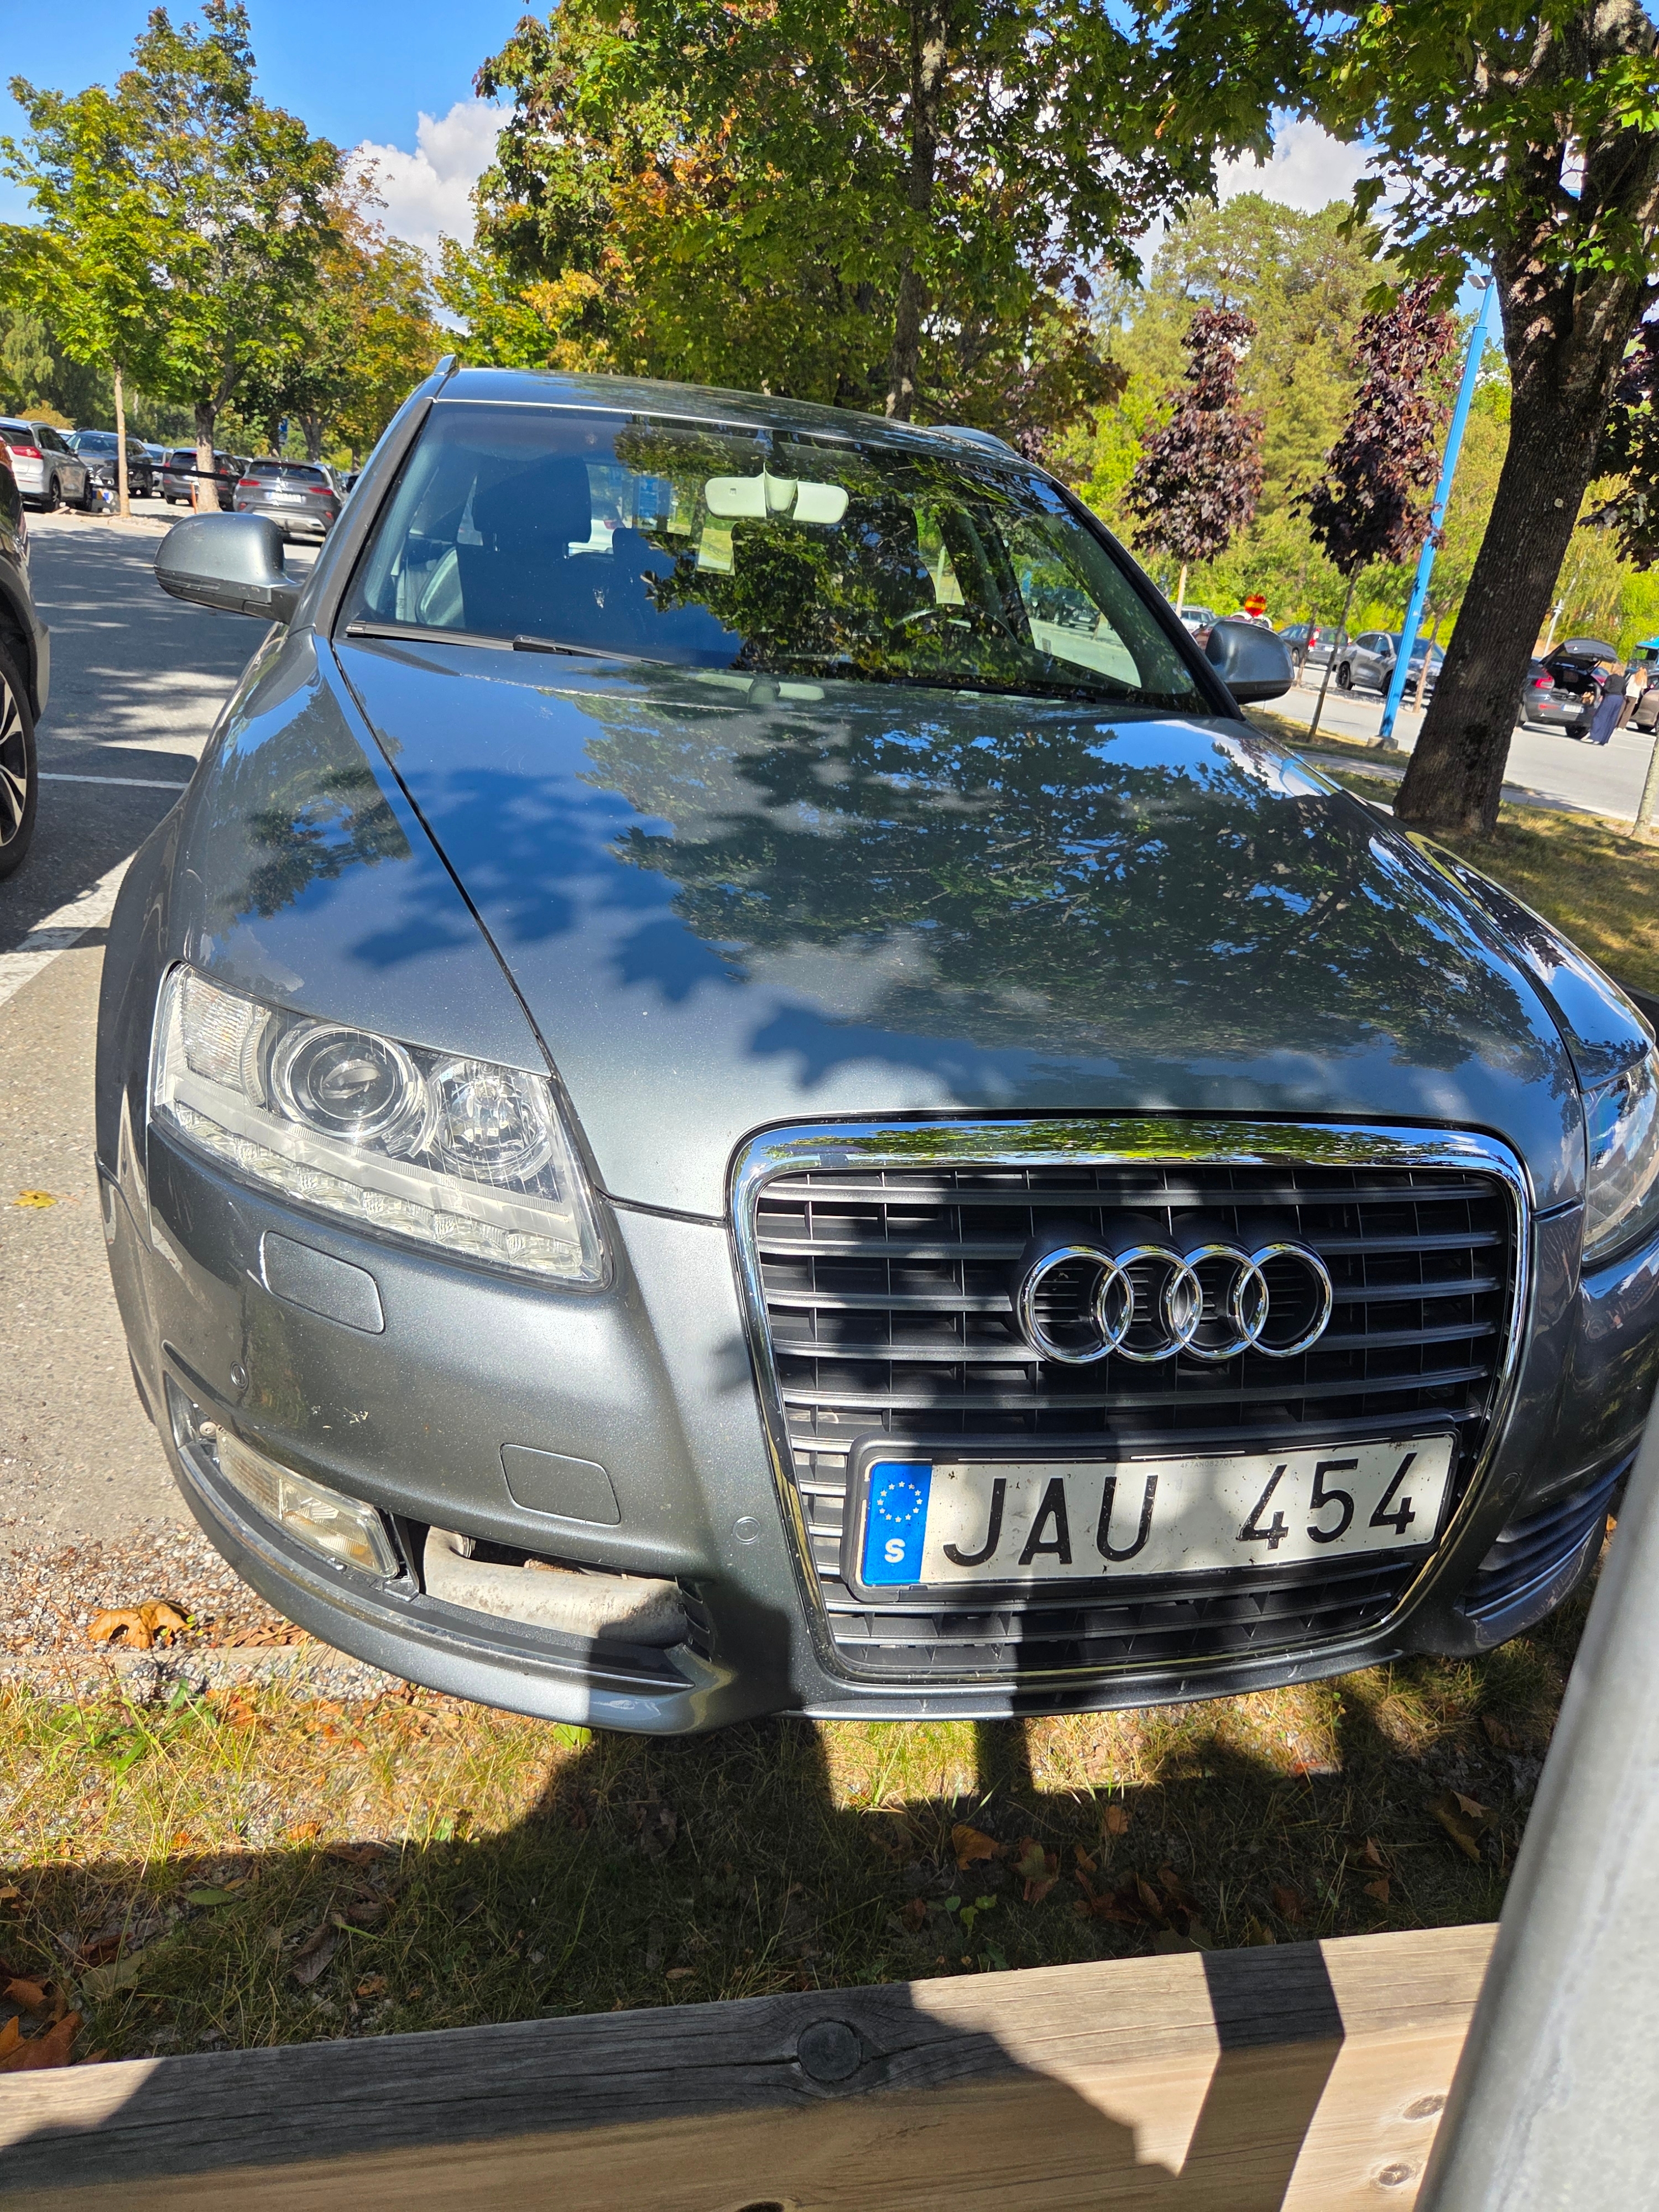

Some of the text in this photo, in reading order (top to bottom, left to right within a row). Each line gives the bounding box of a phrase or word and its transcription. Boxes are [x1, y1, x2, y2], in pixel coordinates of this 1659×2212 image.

[943, 1452, 1417, 1567] JAU 454
[884, 1538, 905, 1563] S
